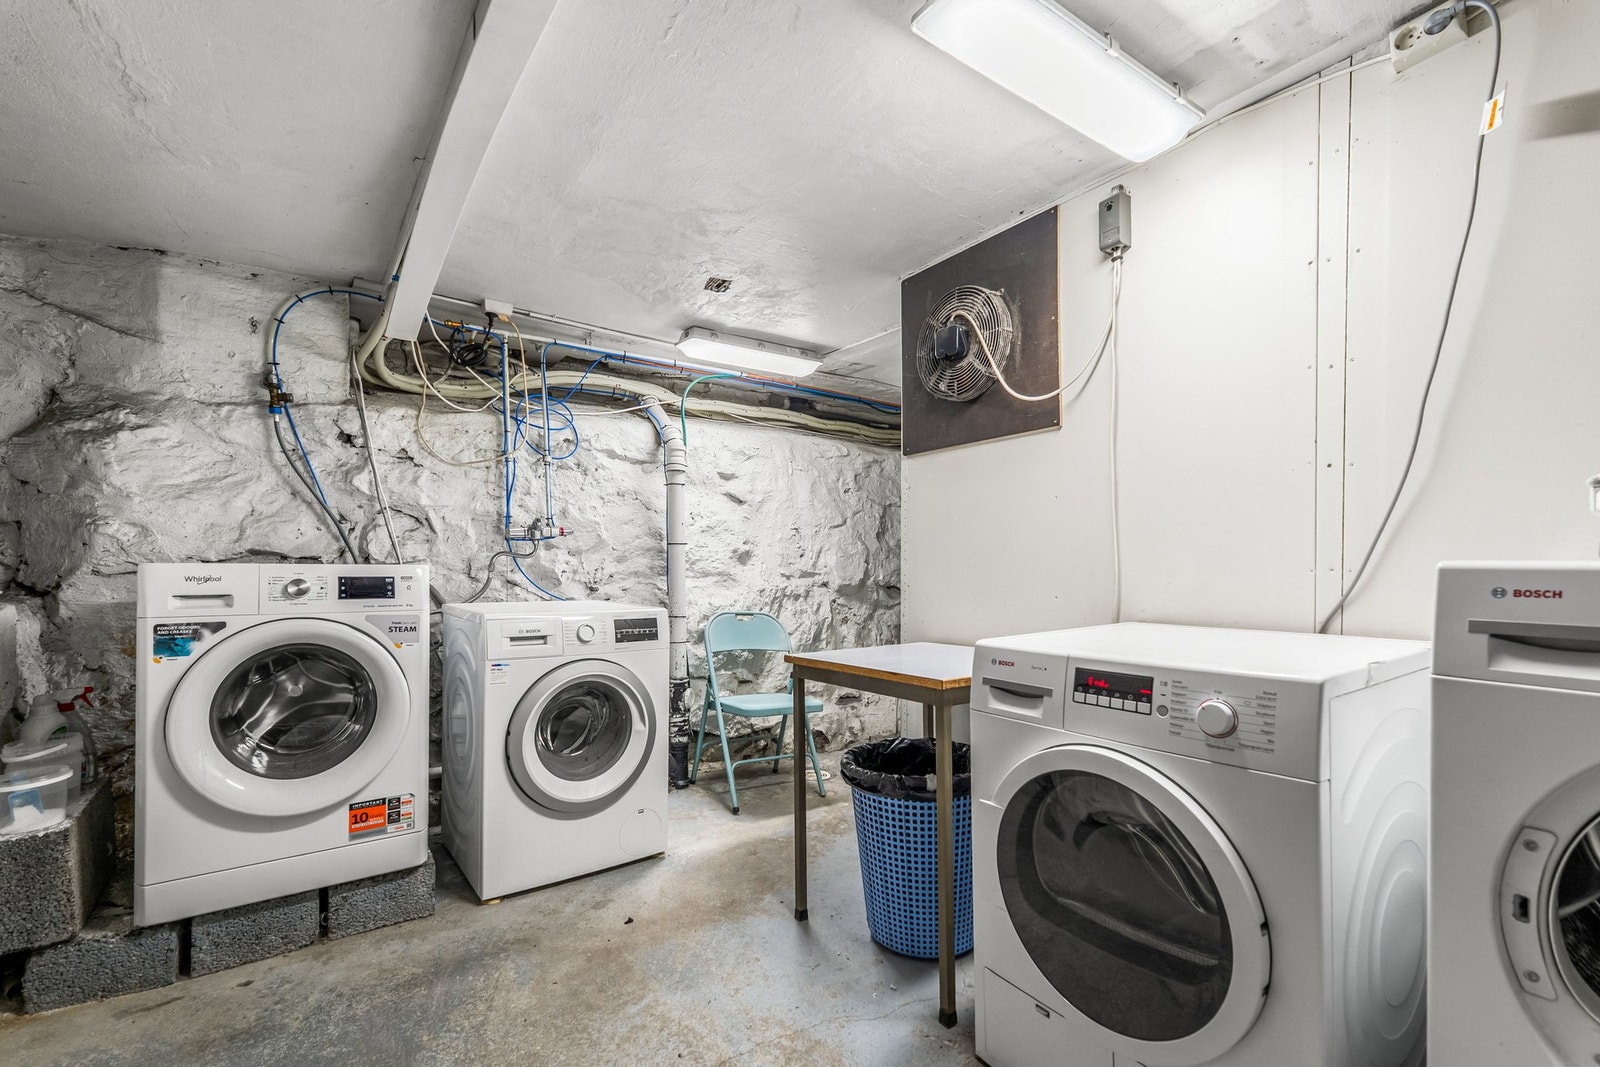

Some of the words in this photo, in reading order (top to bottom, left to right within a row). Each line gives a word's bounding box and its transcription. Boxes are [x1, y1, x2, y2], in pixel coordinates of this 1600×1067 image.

[184, 575, 222, 585] Whirlpool
[1512, 589, 1563, 599] BOSCH
[352, 800, 383, 809] IMPORTANT
[352, 812, 369, 825] 10
